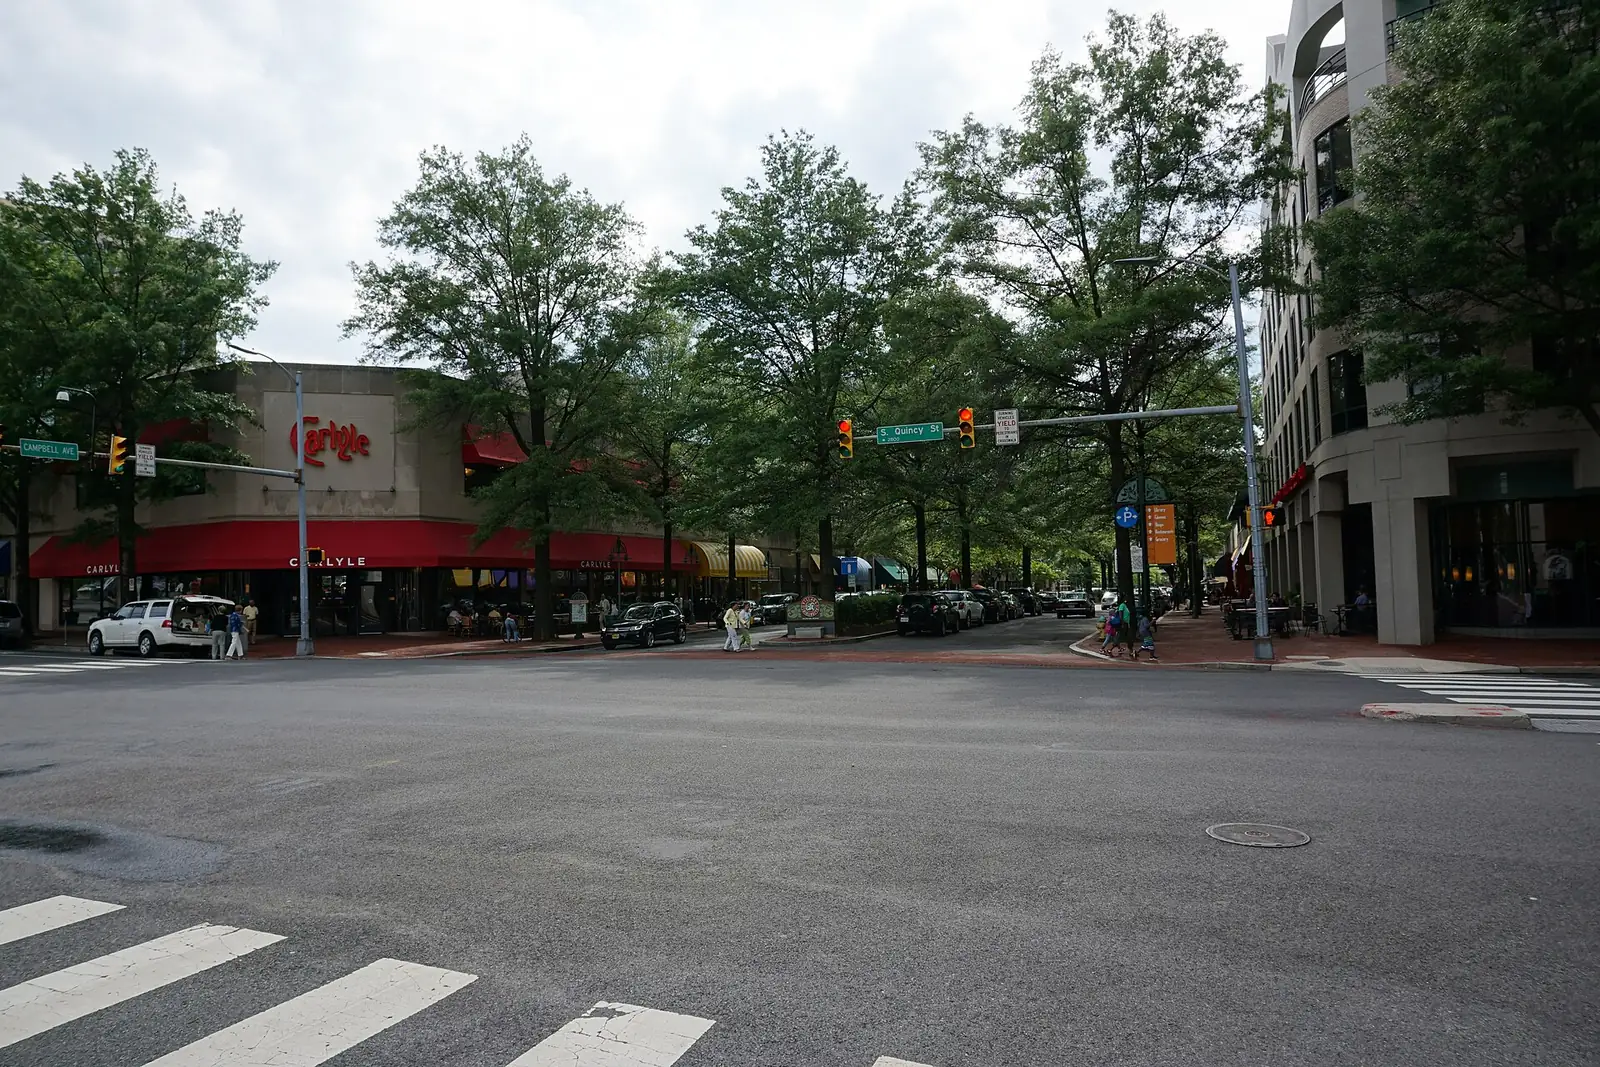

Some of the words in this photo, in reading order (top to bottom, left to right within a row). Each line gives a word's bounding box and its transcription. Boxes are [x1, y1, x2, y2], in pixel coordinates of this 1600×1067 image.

[880, 428, 889, 436] S.
[894, 426, 924, 435] Quincy
[930, 424, 940, 433] St
[290, 416, 369, 467] Carlyle
[23, 442, 59, 454] CAMPBELL
[62, 446, 75, 456] AVE
[137, 453, 153, 461] YIELD
[1123, 511, 1132, 522] P
[289, 557, 366, 567] CLYLE
[580, 560, 611, 568] CARLYLE
[86, 564, 120, 574] CARLYL
